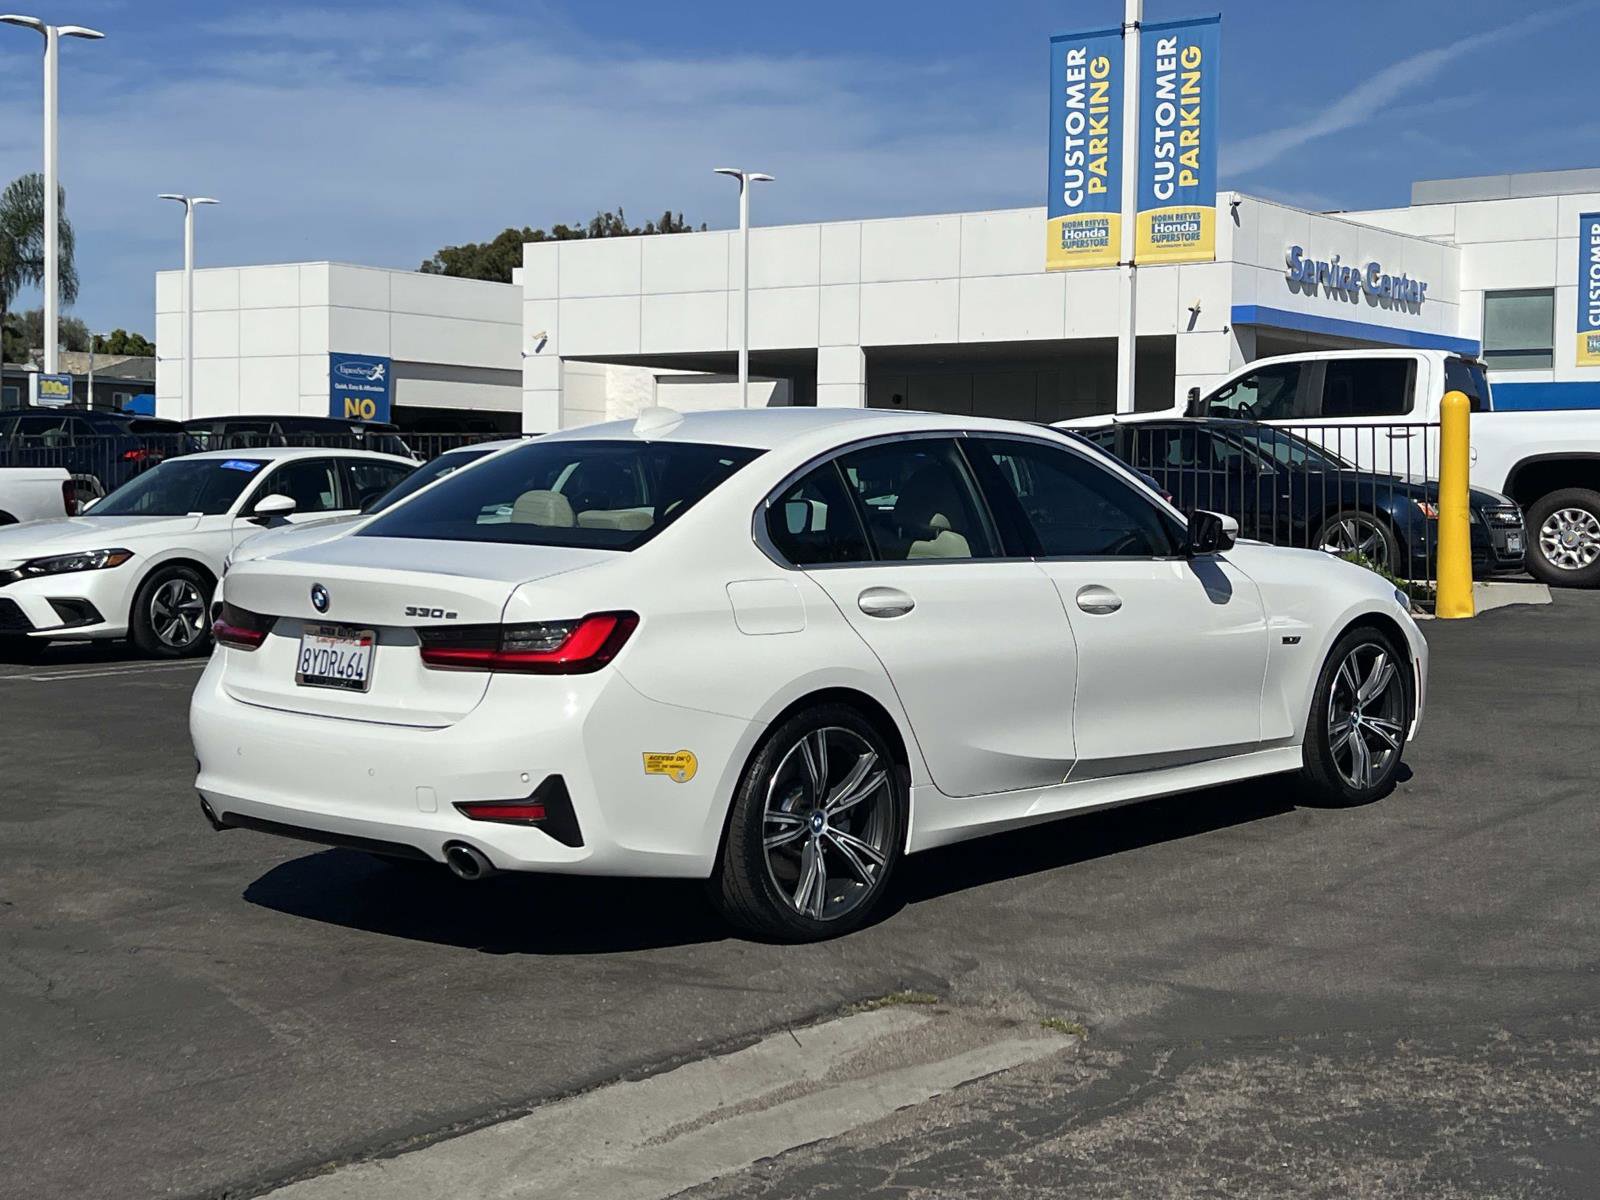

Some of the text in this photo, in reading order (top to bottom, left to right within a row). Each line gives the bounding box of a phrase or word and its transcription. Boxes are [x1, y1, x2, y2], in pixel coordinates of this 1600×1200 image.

[1063, 46, 1087, 207] CUSTOMER
[1088, 56, 1110, 194] PARKING
[1153, 35, 1177, 200] CUSTOMER
[1178, 46, 1202, 187] PARKING
[1062, 218, 1109, 229] NORM REEVES
[1152, 212, 1201, 223] NORM REEVES
[1154, 221, 1198, 233] Honda
[1061, 238, 1109, 249] SUPERSTORE
[1064, 228, 1106, 240] Honda
[1151, 231, 1201, 243] SUPERSTORE
[1286, 245, 1428, 303] Service Center
[344, 398, 376, 419] NO
[301, 647, 364, 680] 8YDR464
